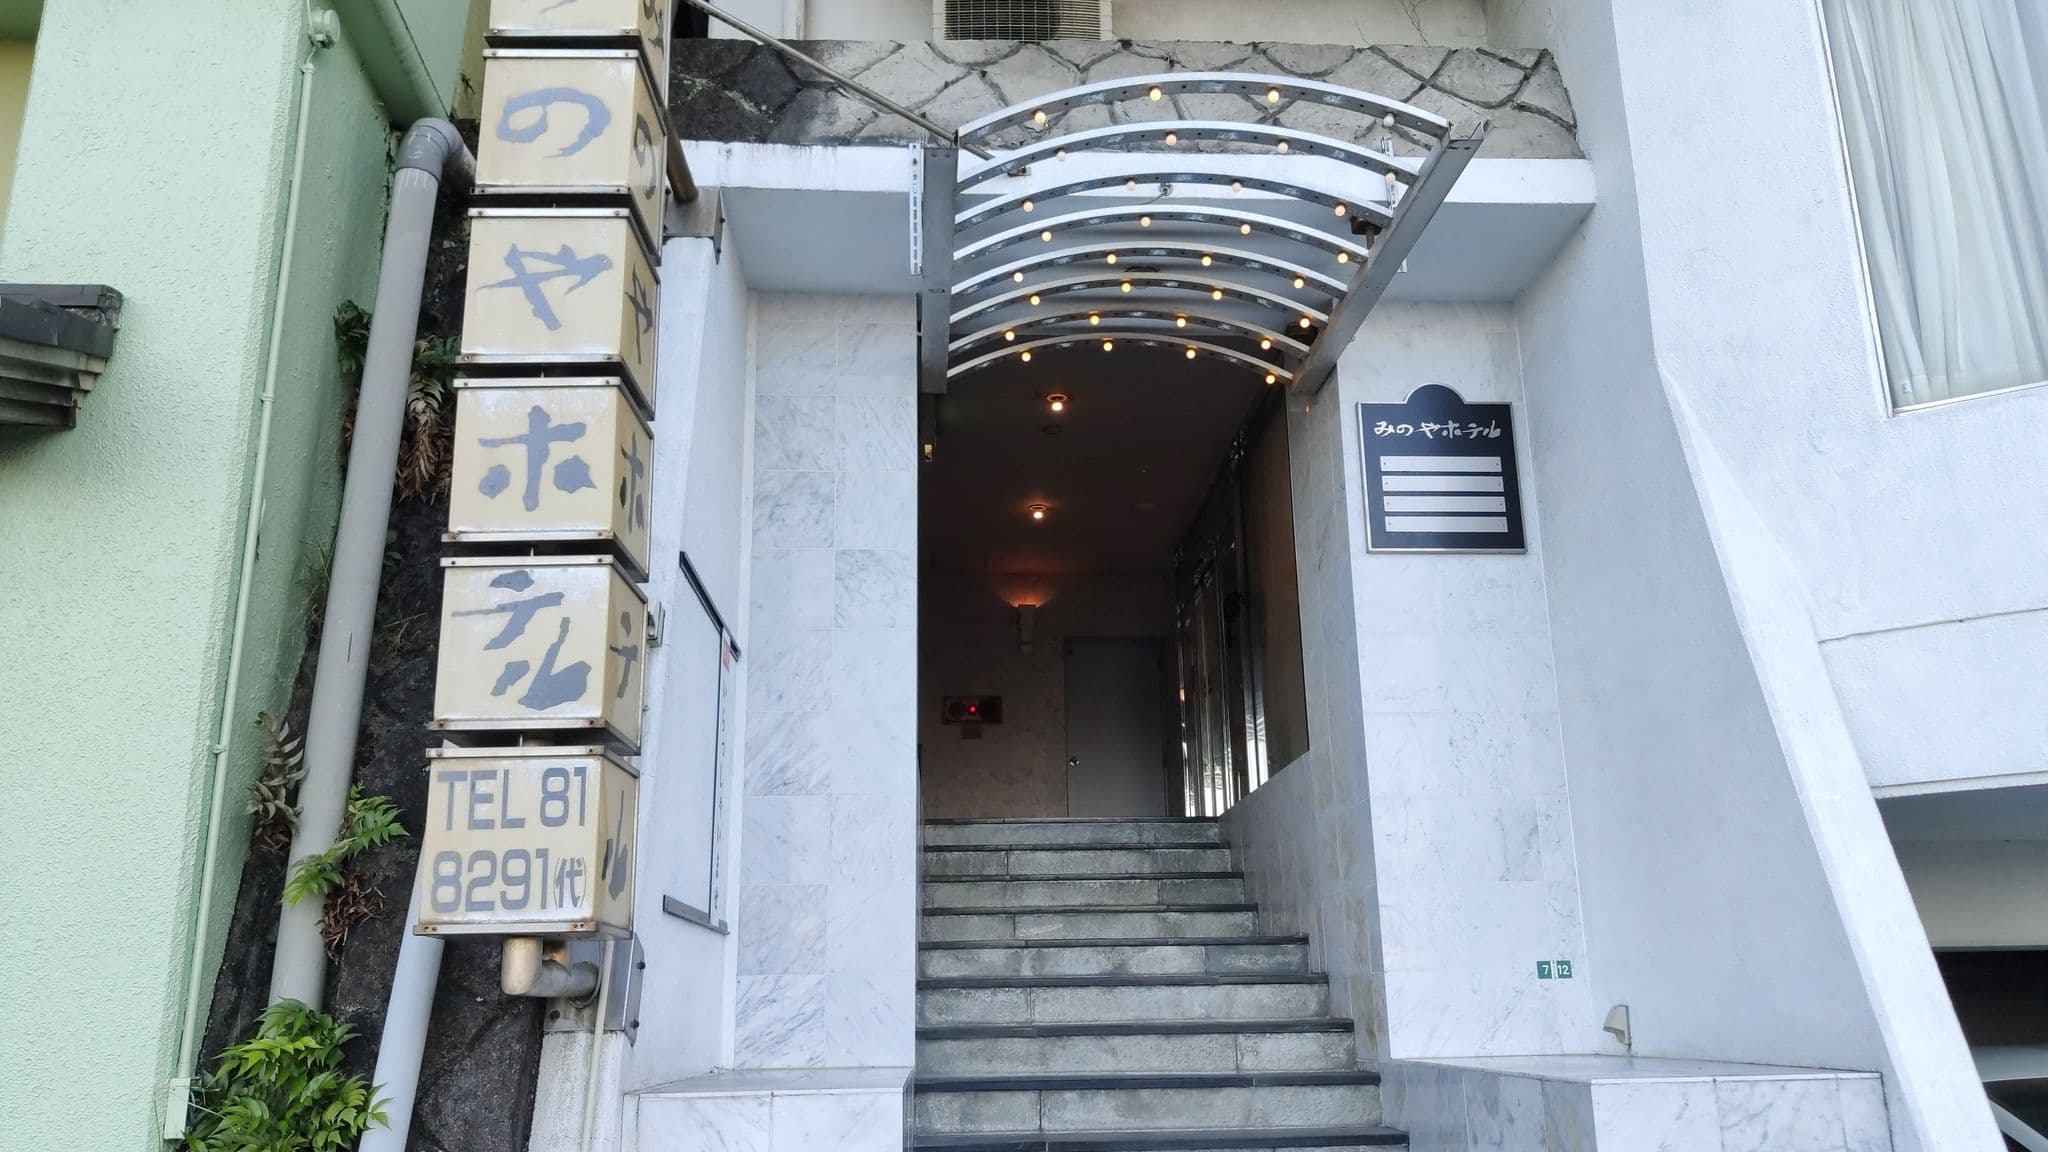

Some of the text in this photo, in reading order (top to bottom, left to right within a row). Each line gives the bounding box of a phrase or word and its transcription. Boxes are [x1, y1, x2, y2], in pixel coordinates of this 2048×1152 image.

[452, 0, 613, 711] のやホテル
[1374, 420, 1501, 439] みのやホテル
[437, 766, 587, 831] TEL 81
[1541, 964, 1549, 975] 7
[1557, 964, 1570, 975] 12
